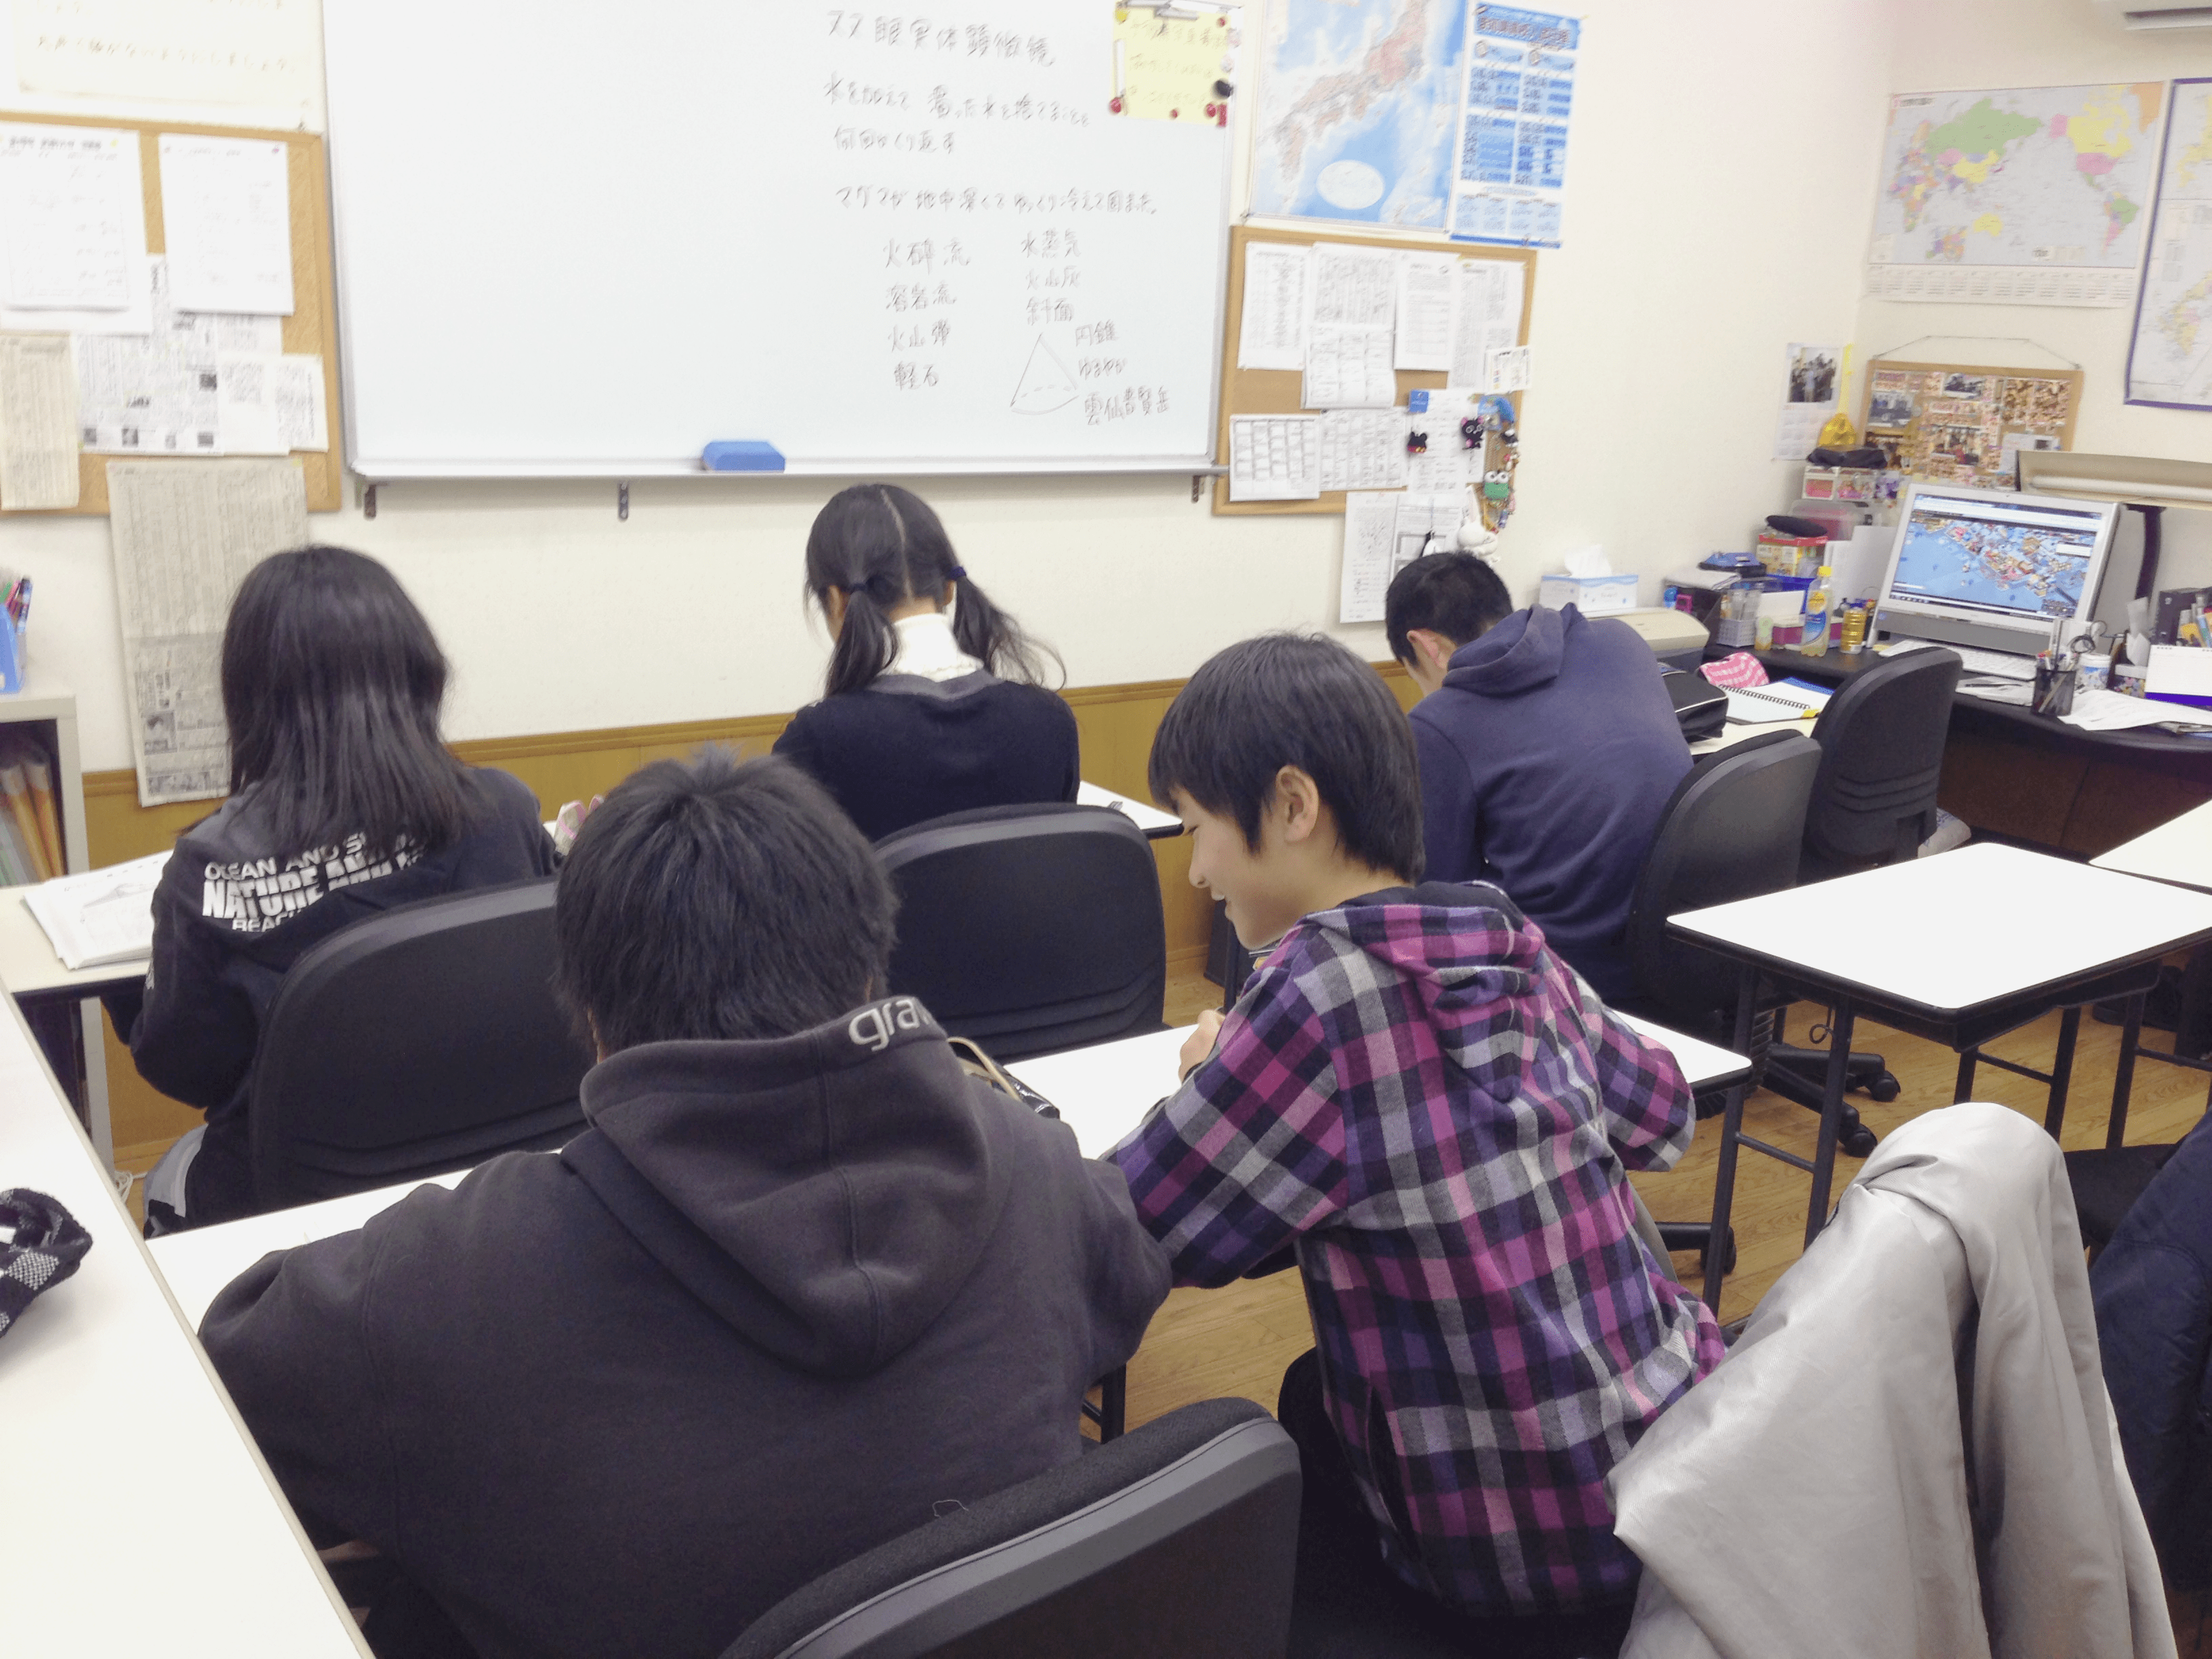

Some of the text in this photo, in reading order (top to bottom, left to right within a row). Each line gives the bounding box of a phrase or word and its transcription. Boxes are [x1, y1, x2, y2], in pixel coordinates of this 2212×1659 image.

[882, 237, 971, 275] 火砕流
[1025, 265, 1081, 291] 火山灰
[885, 280, 958, 313] 溶岩流
[1025, 296, 1075, 327] 斜面
[893, 361, 939, 392] 軽石
[204, 856, 276, 881] OCEAN
